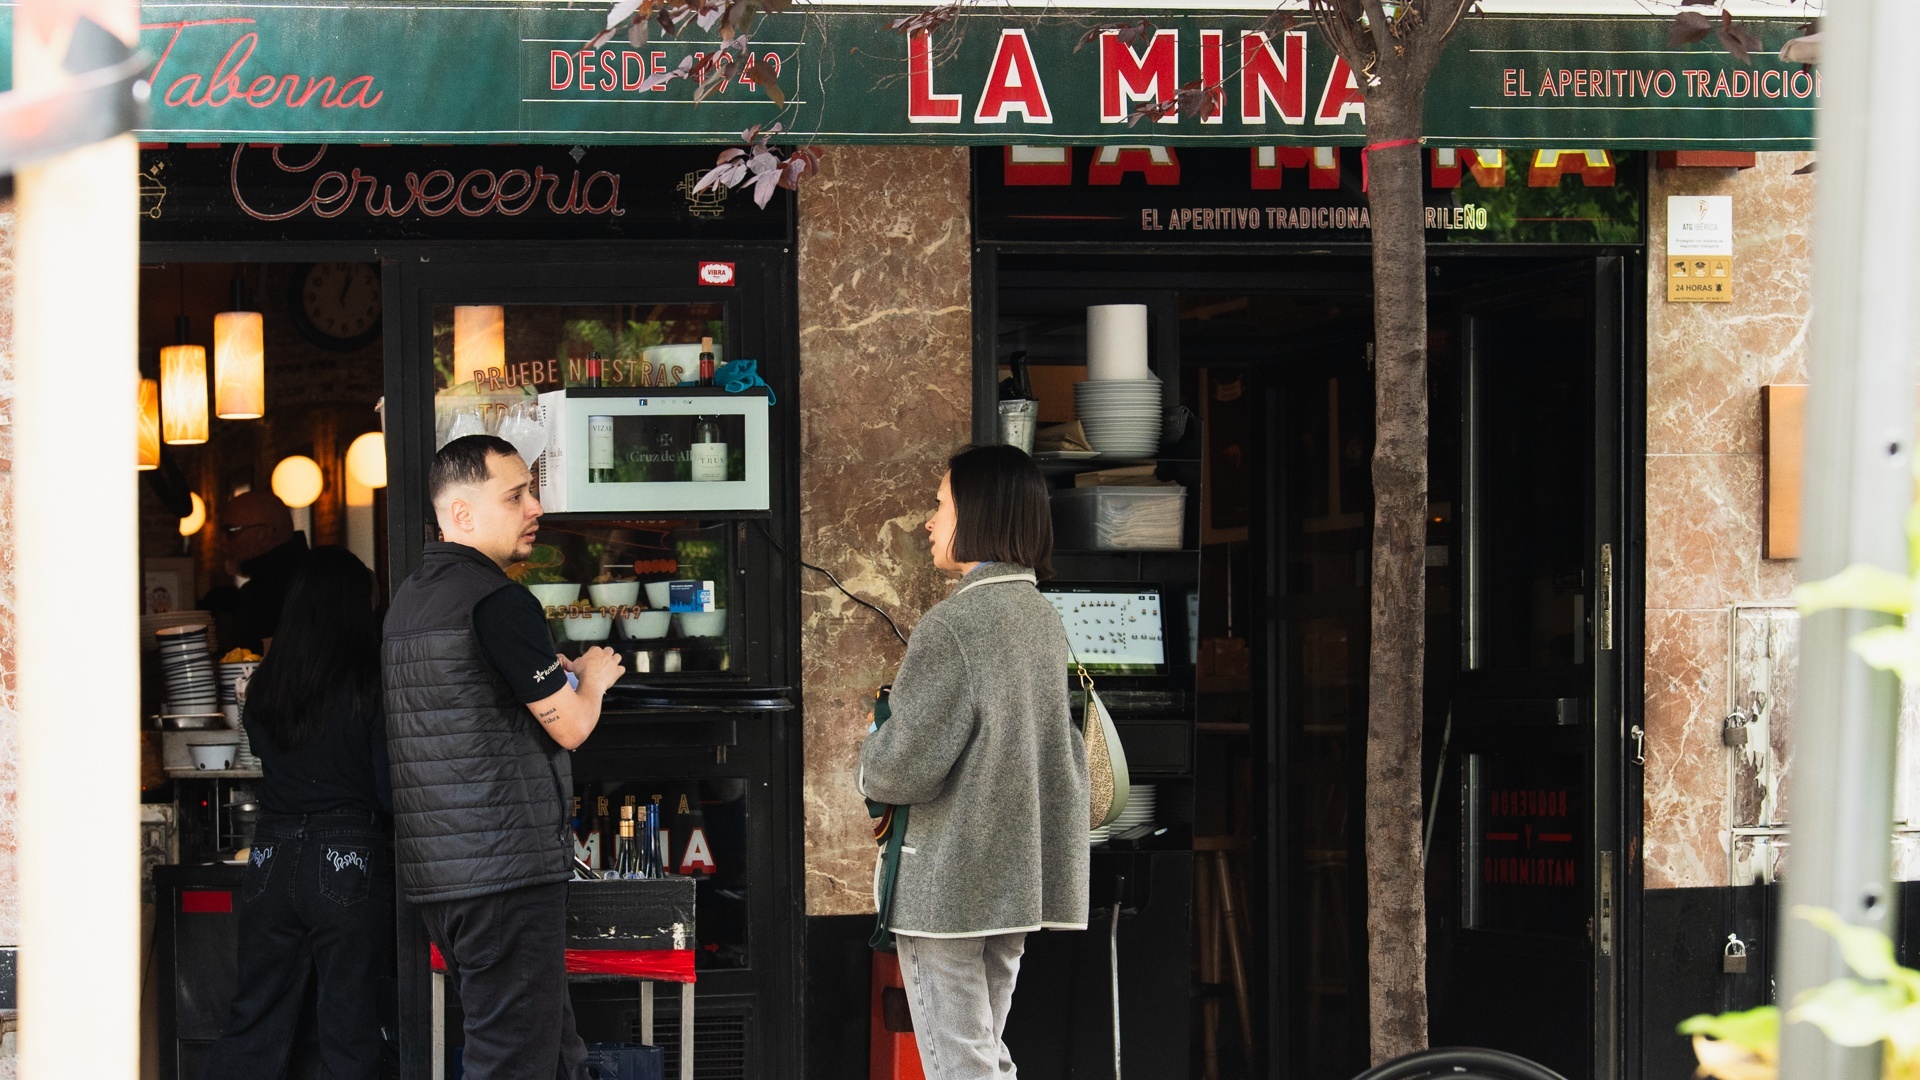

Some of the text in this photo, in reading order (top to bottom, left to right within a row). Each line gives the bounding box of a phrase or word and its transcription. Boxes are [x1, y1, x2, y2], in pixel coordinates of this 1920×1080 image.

[138, 18, 384, 109] Taberna
[550, 49, 667, 92] DESDE
[906, 27, 1366, 125] LA MINA
[1503, 68, 1531, 97] EL
[1538, 67, 1676, 97] APERITIVO
[1142, 208, 1163, 231] EL
[1169, 207, 1260, 230] APERITIVO
[1675, 284, 1713, 292] 24 HORAS
[473, 357, 684, 394] PRUEBE NESTRAS
[630, 450, 659, 462] Cruz
[661, 450, 676, 462] de
[600, 605, 641, 620] 1949
[573, 827, 717, 874] MA
